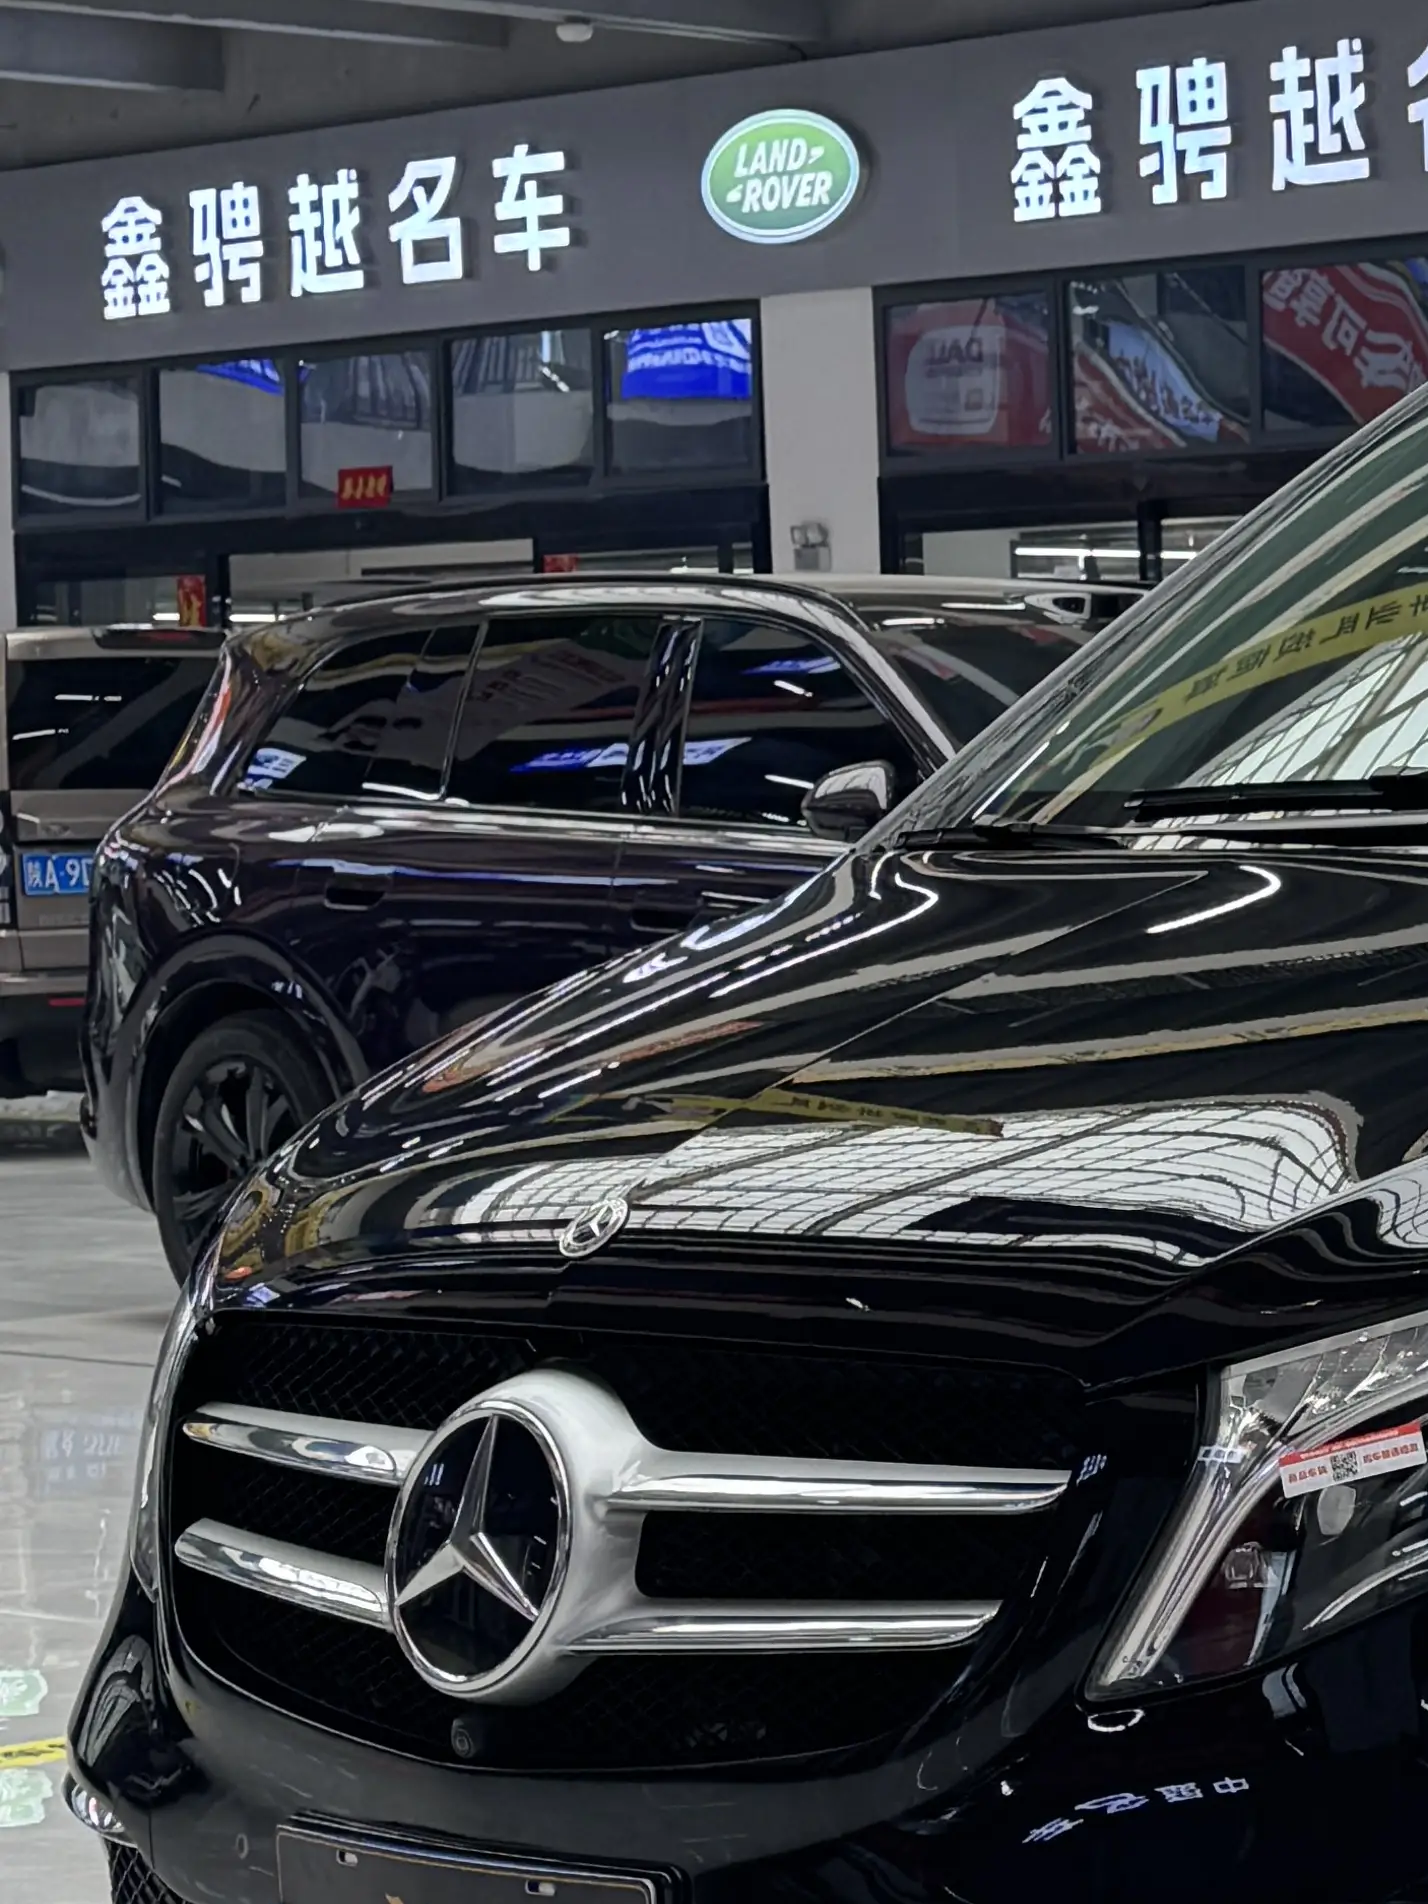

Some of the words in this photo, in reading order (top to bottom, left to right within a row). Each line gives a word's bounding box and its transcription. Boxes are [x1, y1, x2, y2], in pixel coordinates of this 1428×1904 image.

[734, 138, 808, 178] LAND
[741, 170, 834, 213] ROVER
[100, 142, 571, 321] 鑫骋越名车
